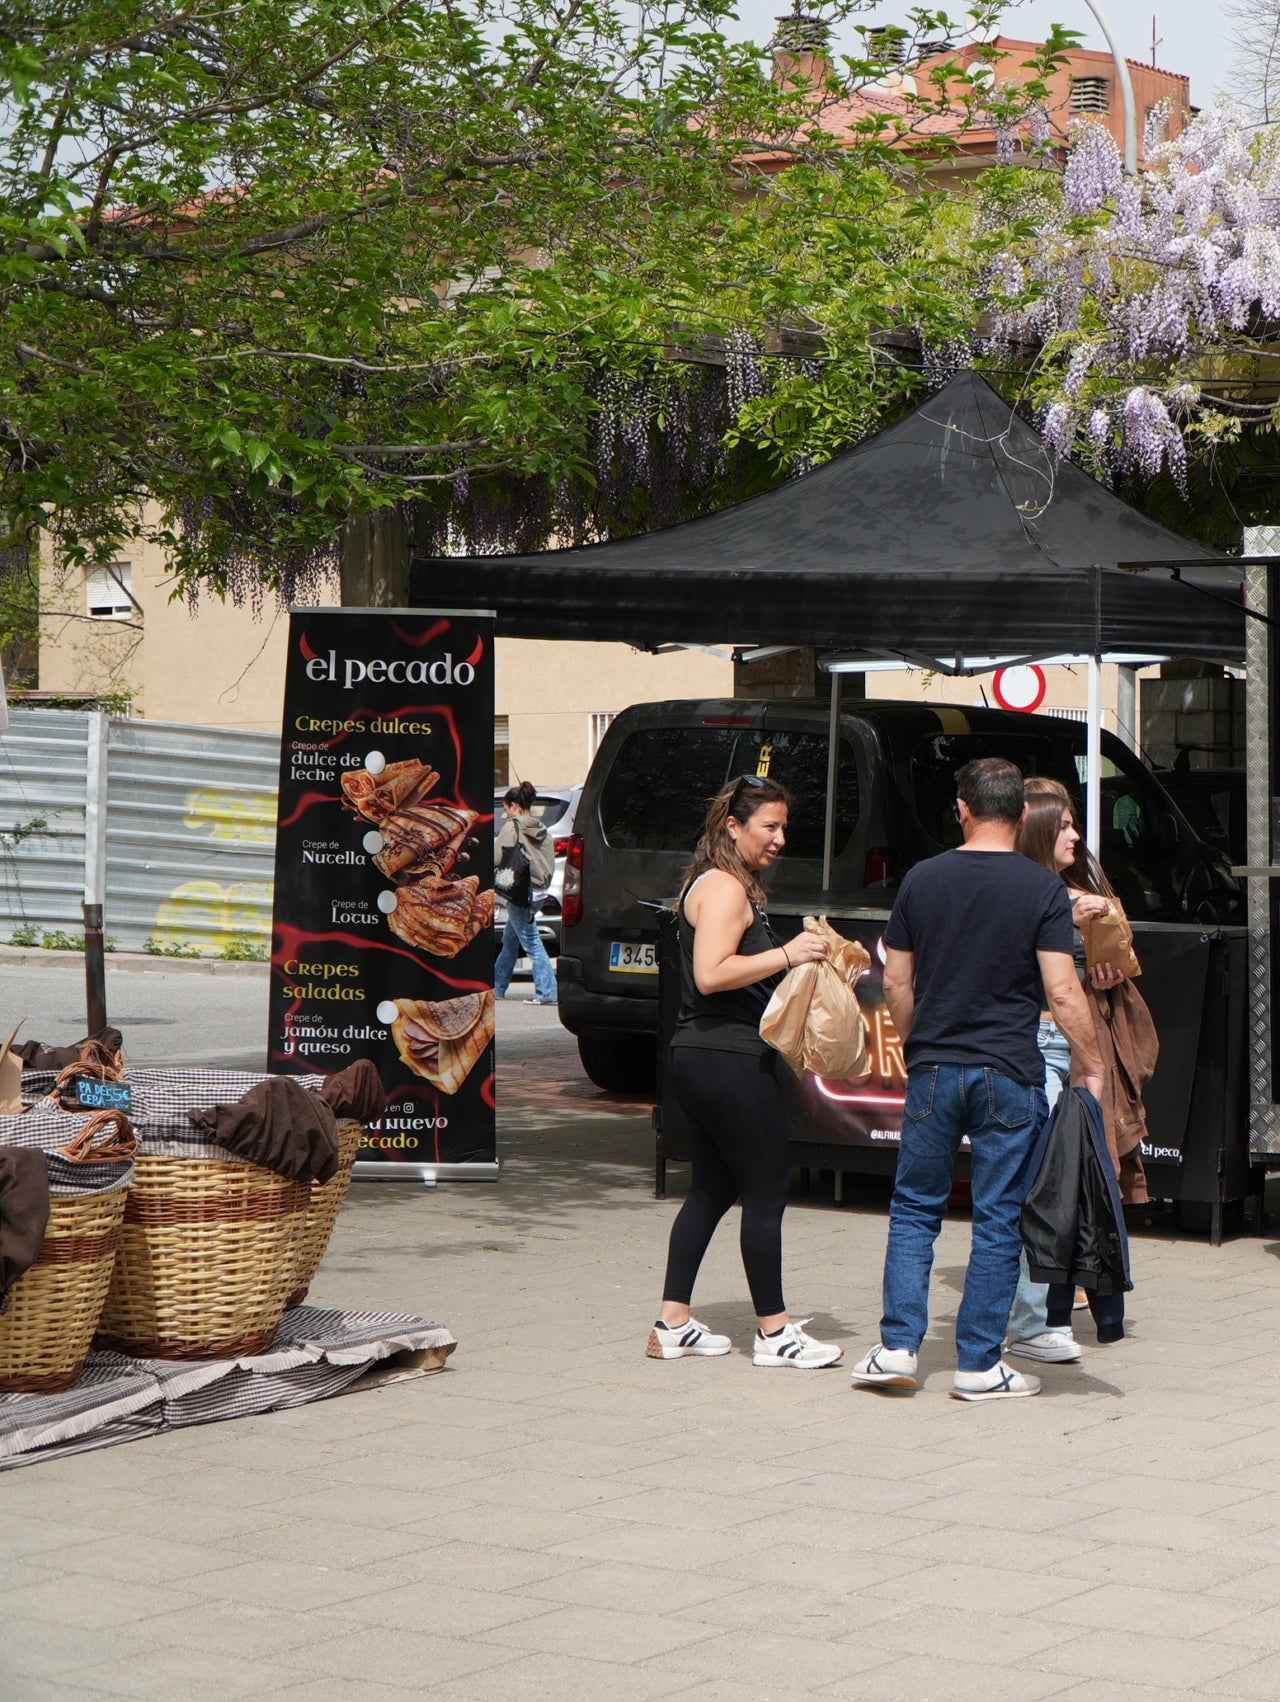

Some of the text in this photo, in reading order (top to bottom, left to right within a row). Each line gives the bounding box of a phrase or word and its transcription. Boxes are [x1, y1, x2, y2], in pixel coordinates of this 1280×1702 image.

[305, 649, 475, 689] el pecado
[295, 715, 433, 736] Crepes dulces
[291, 740, 329, 752] Crepe de
[291, 750, 361, 768] dulce de
[291, 766, 335, 782] leche
[302, 839, 339, 850] Crepe de
[331, 899, 368, 910] Crepe de
[623, 947, 659, 966] 345
[283, 959, 359, 979] Crepes
[282, 983, 365, 1001] saladas
[284, 1012, 323, 1024] Crepe de
[342, 1025, 387, 1041] dulce
[284, 1041, 351, 1056] y queso
[79, 1081, 91, 1093] PA
[365, 1116, 448, 1130] u nuevo
[358, 1132, 419, 1148] ecado
[1141, 1144, 1153, 1155] el
